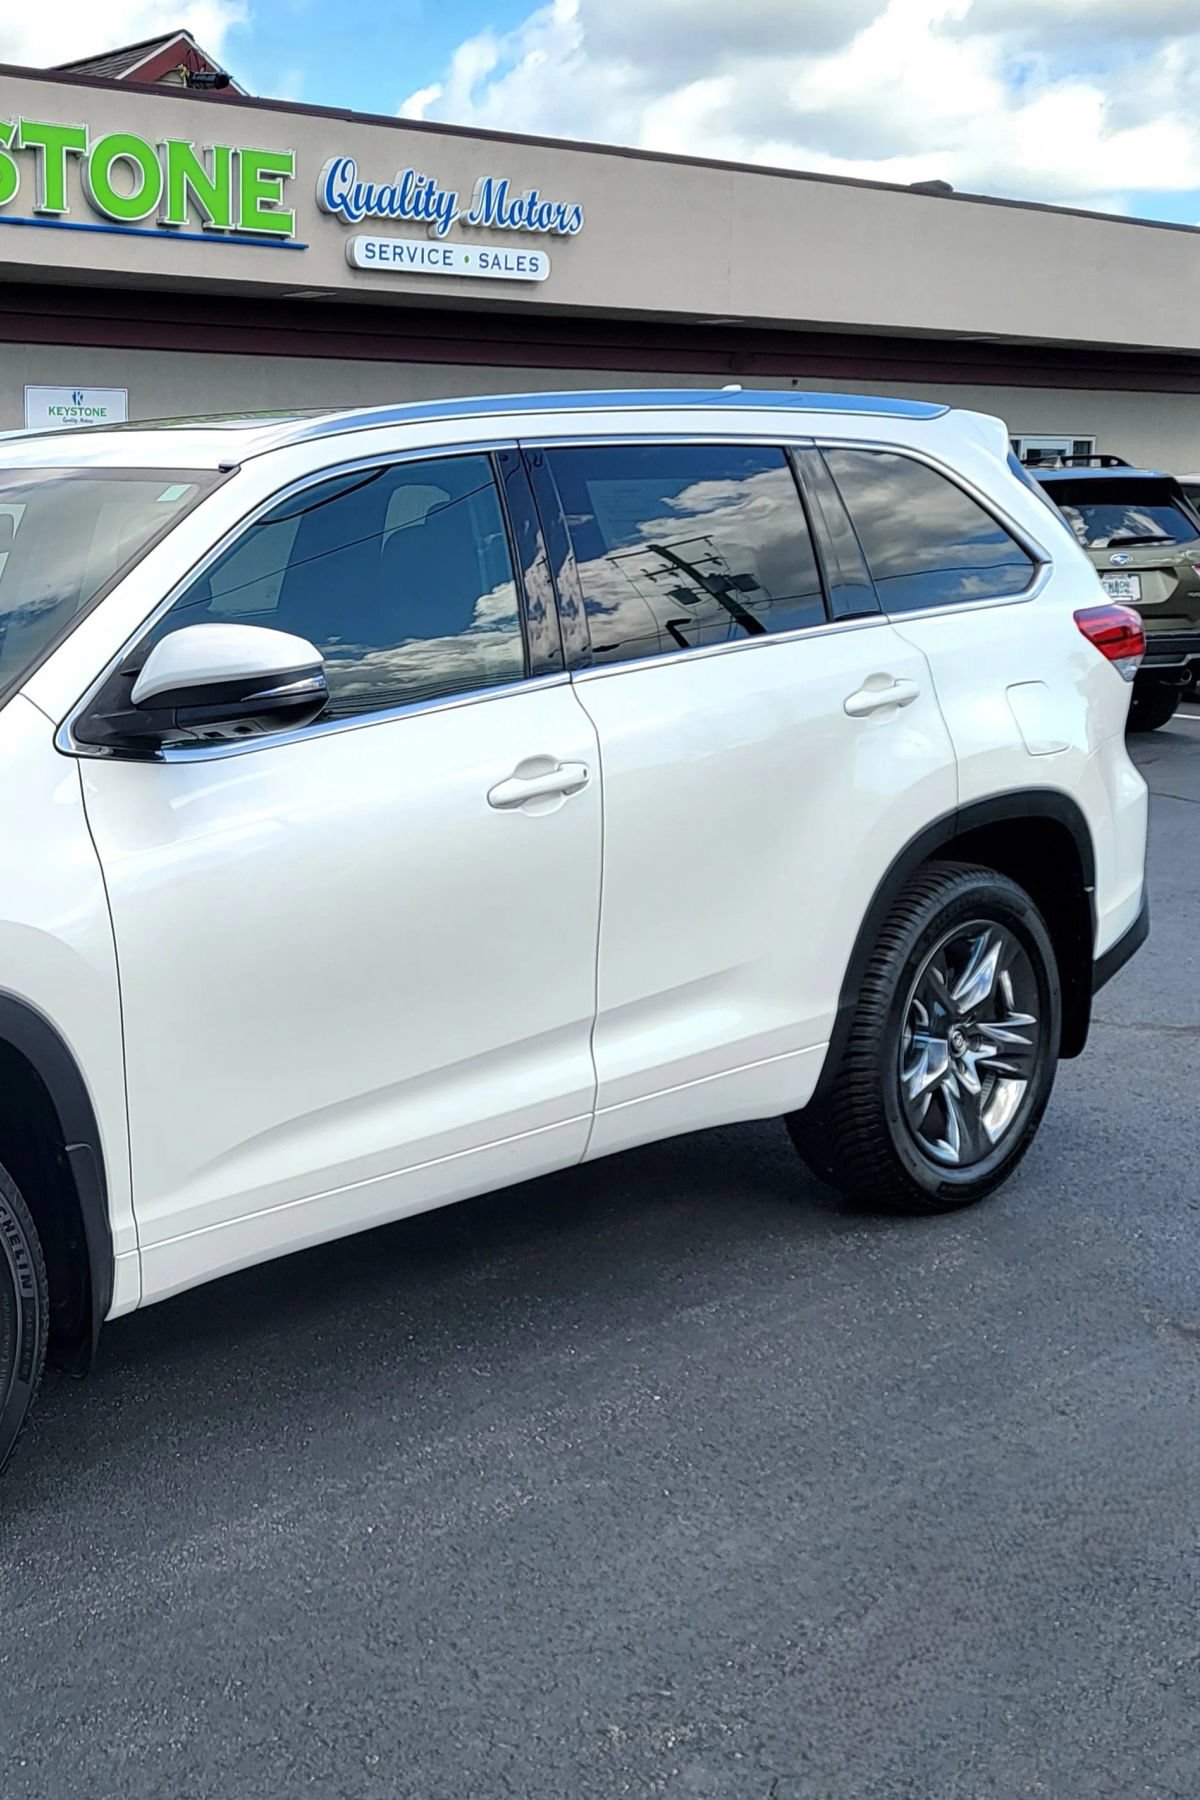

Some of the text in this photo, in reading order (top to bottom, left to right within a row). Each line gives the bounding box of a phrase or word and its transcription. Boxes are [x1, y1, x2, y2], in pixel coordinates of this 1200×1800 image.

[320, 155, 584, 238] Quality Motors
[364, 242, 540, 273] SERVICE SALES
[48, 406, 107, 417] KEYSTONE
